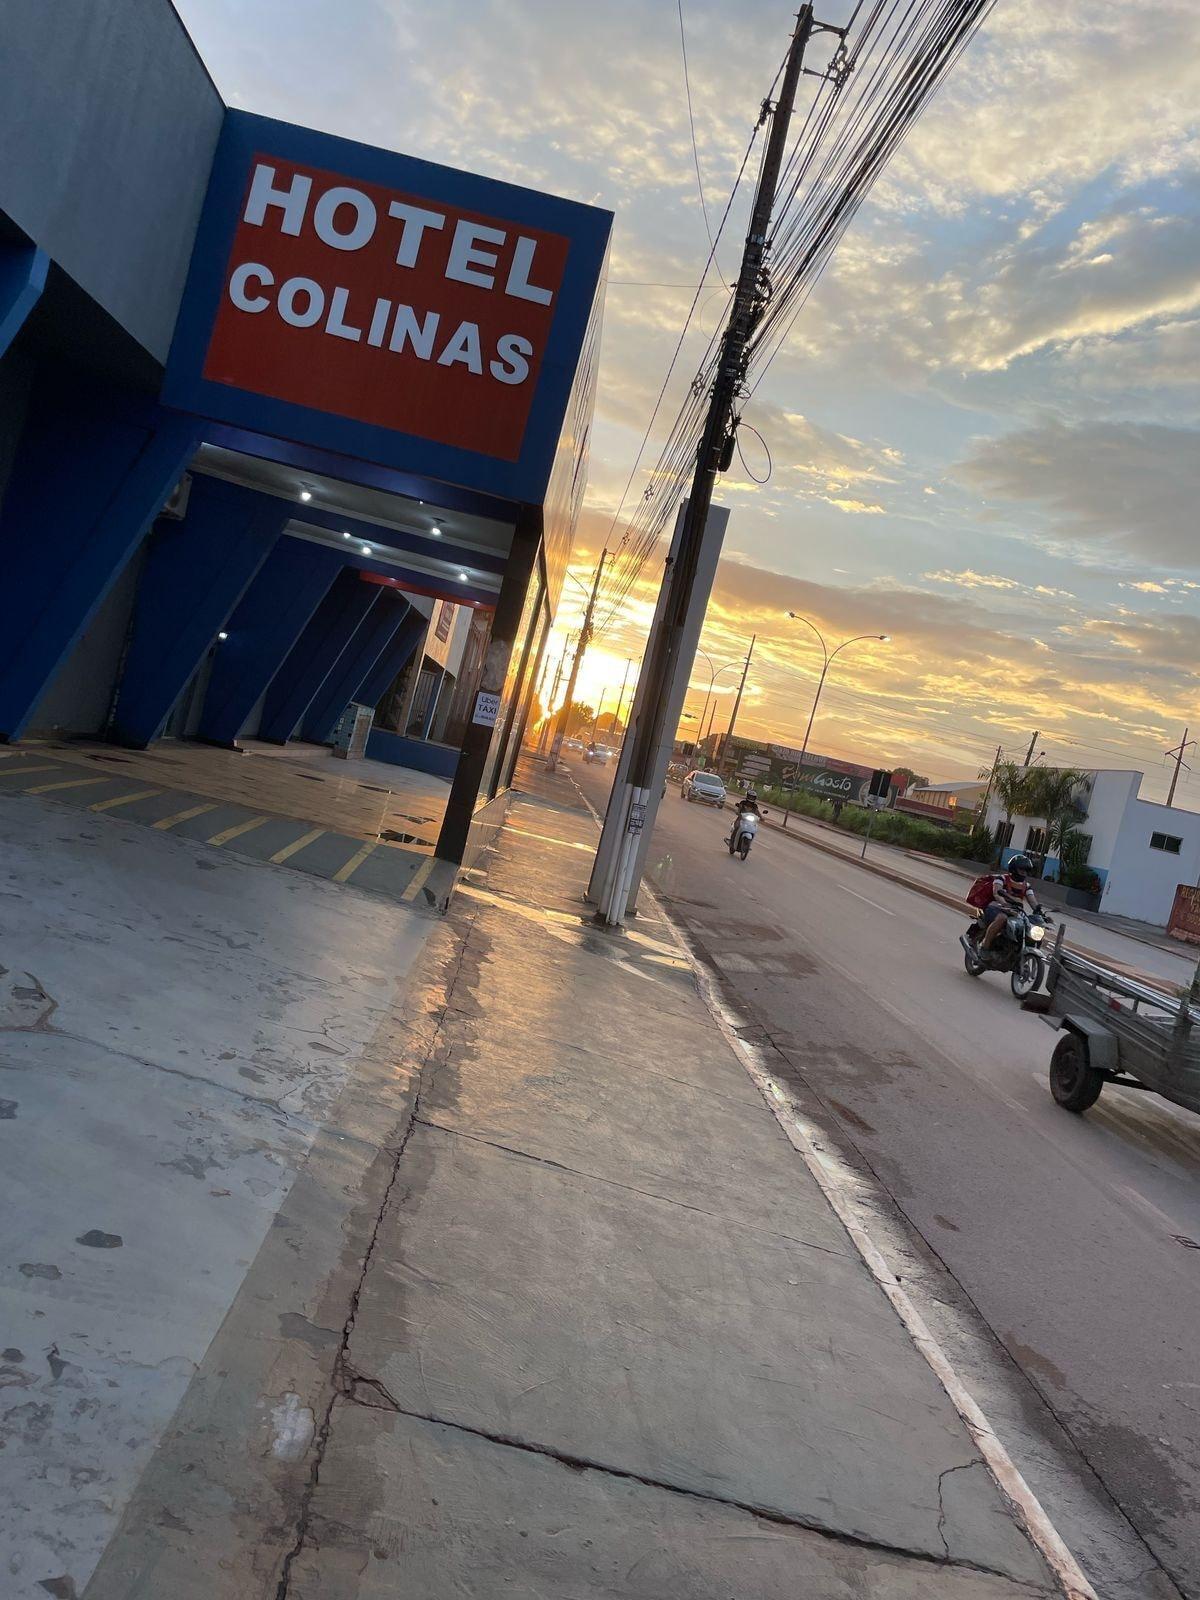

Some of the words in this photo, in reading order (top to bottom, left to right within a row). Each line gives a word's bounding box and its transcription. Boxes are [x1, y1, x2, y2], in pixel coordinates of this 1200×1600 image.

[243, 163, 554, 307] HOTEL
[228, 262, 534, 385] COLINAS
[478, 704, 497, 714] TAXI
